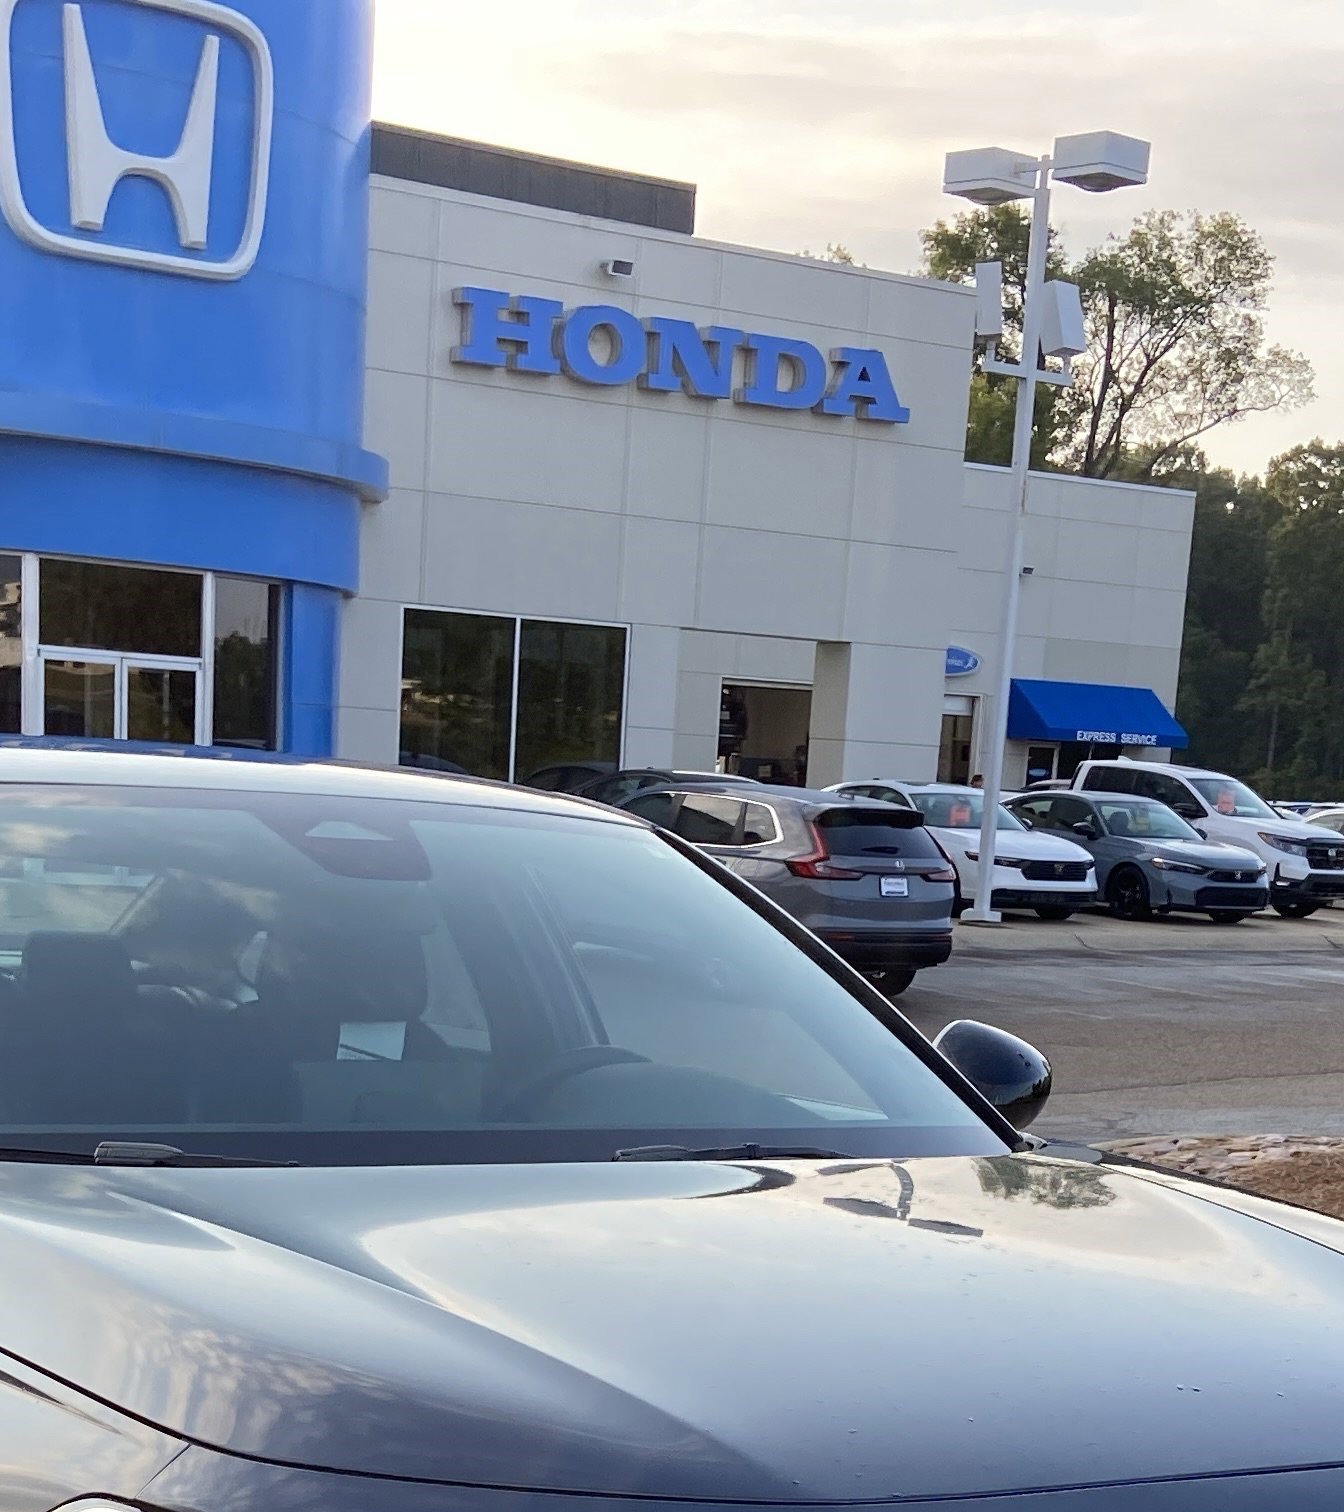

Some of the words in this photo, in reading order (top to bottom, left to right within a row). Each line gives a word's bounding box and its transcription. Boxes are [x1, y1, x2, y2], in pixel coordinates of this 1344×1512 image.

[451, 286, 910, 424] HONDA
[1076, 730, 1116, 743] EXPRESS
[1120, 733, 1157, 745] SERVICE
